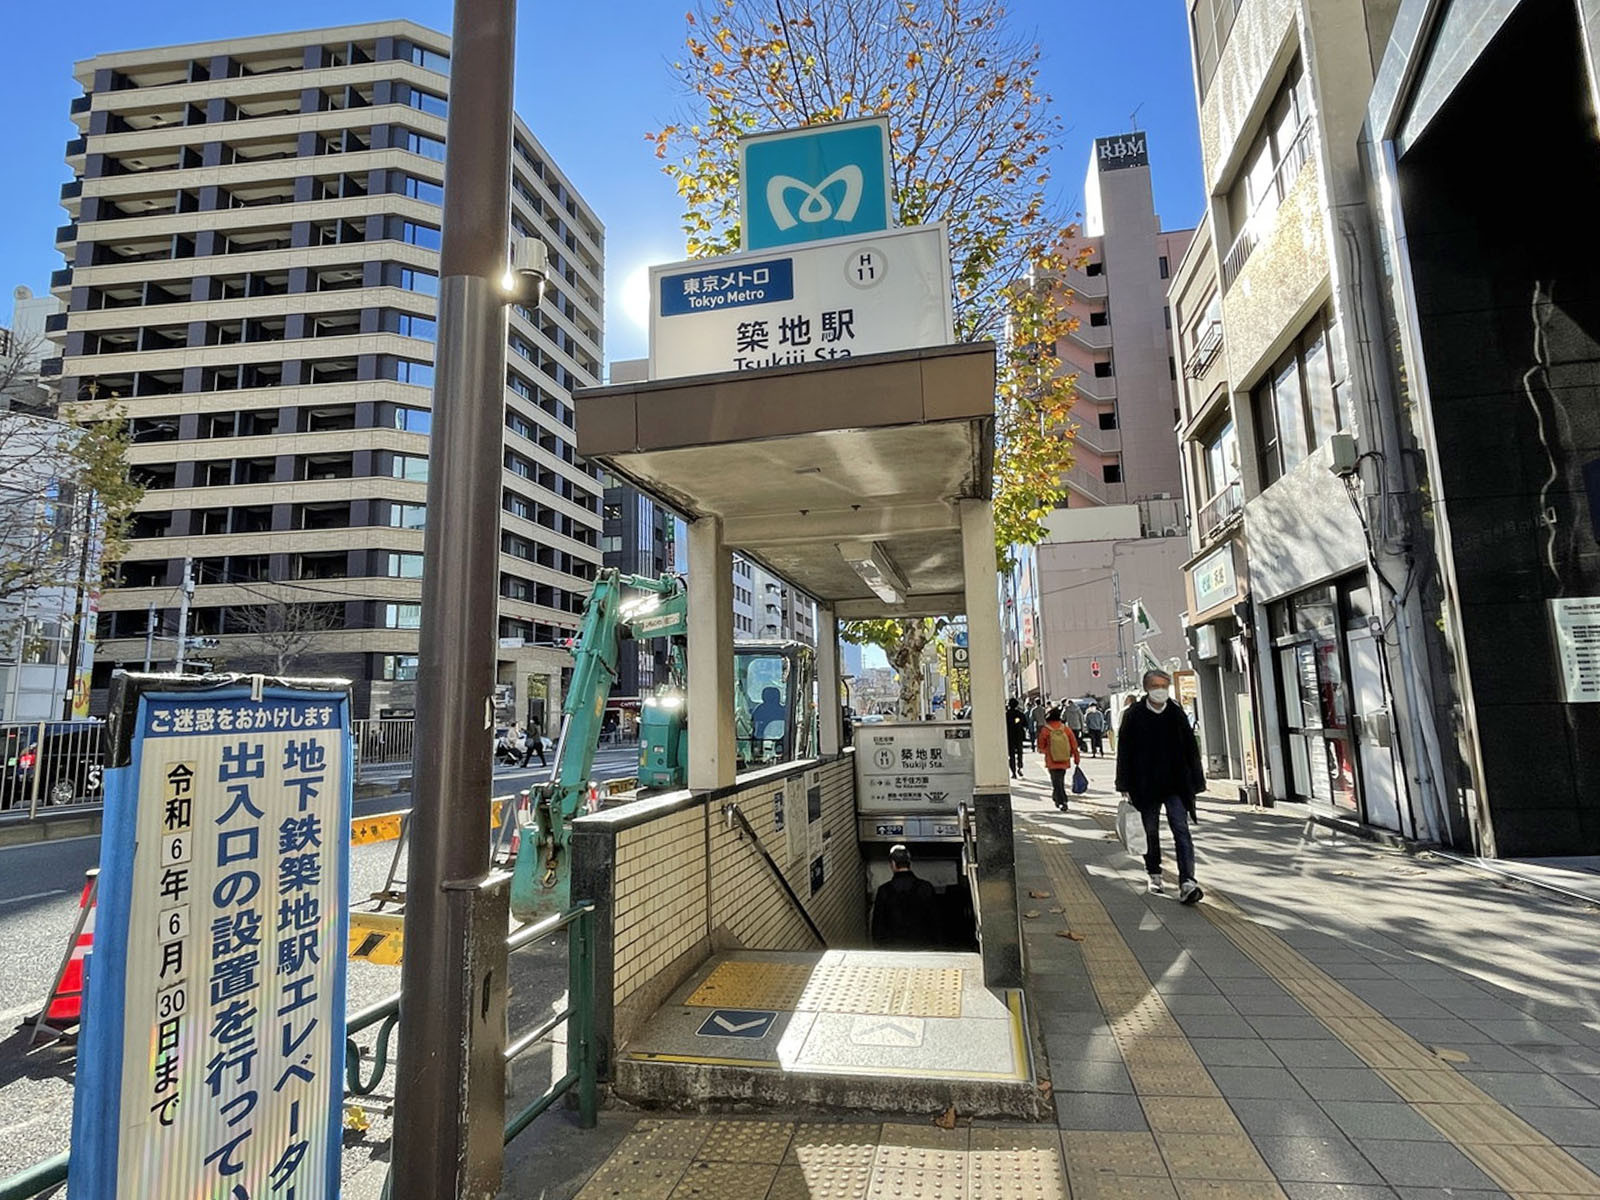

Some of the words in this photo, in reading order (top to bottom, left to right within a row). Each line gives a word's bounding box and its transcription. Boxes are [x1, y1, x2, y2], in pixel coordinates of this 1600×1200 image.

[1099, 140, 1145, 158] RBM
[860, 254, 871, 266] H
[683, 267, 770, 295] 東京メトロ
[857, 267, 875, 281] 11
[688, 294, 725, 309] Tokyo
[727, 288, 765, 303] Metro
[736, 308, 855, 353] 築地駅
[151, 706, 334, 733] ご迷惑をおかけします
[901, 748, 943, 760] 築地駅
[901, 761, 927, 769] Tsukiji
[150, 763, 194, 1127] 令和6年6月30日まで
